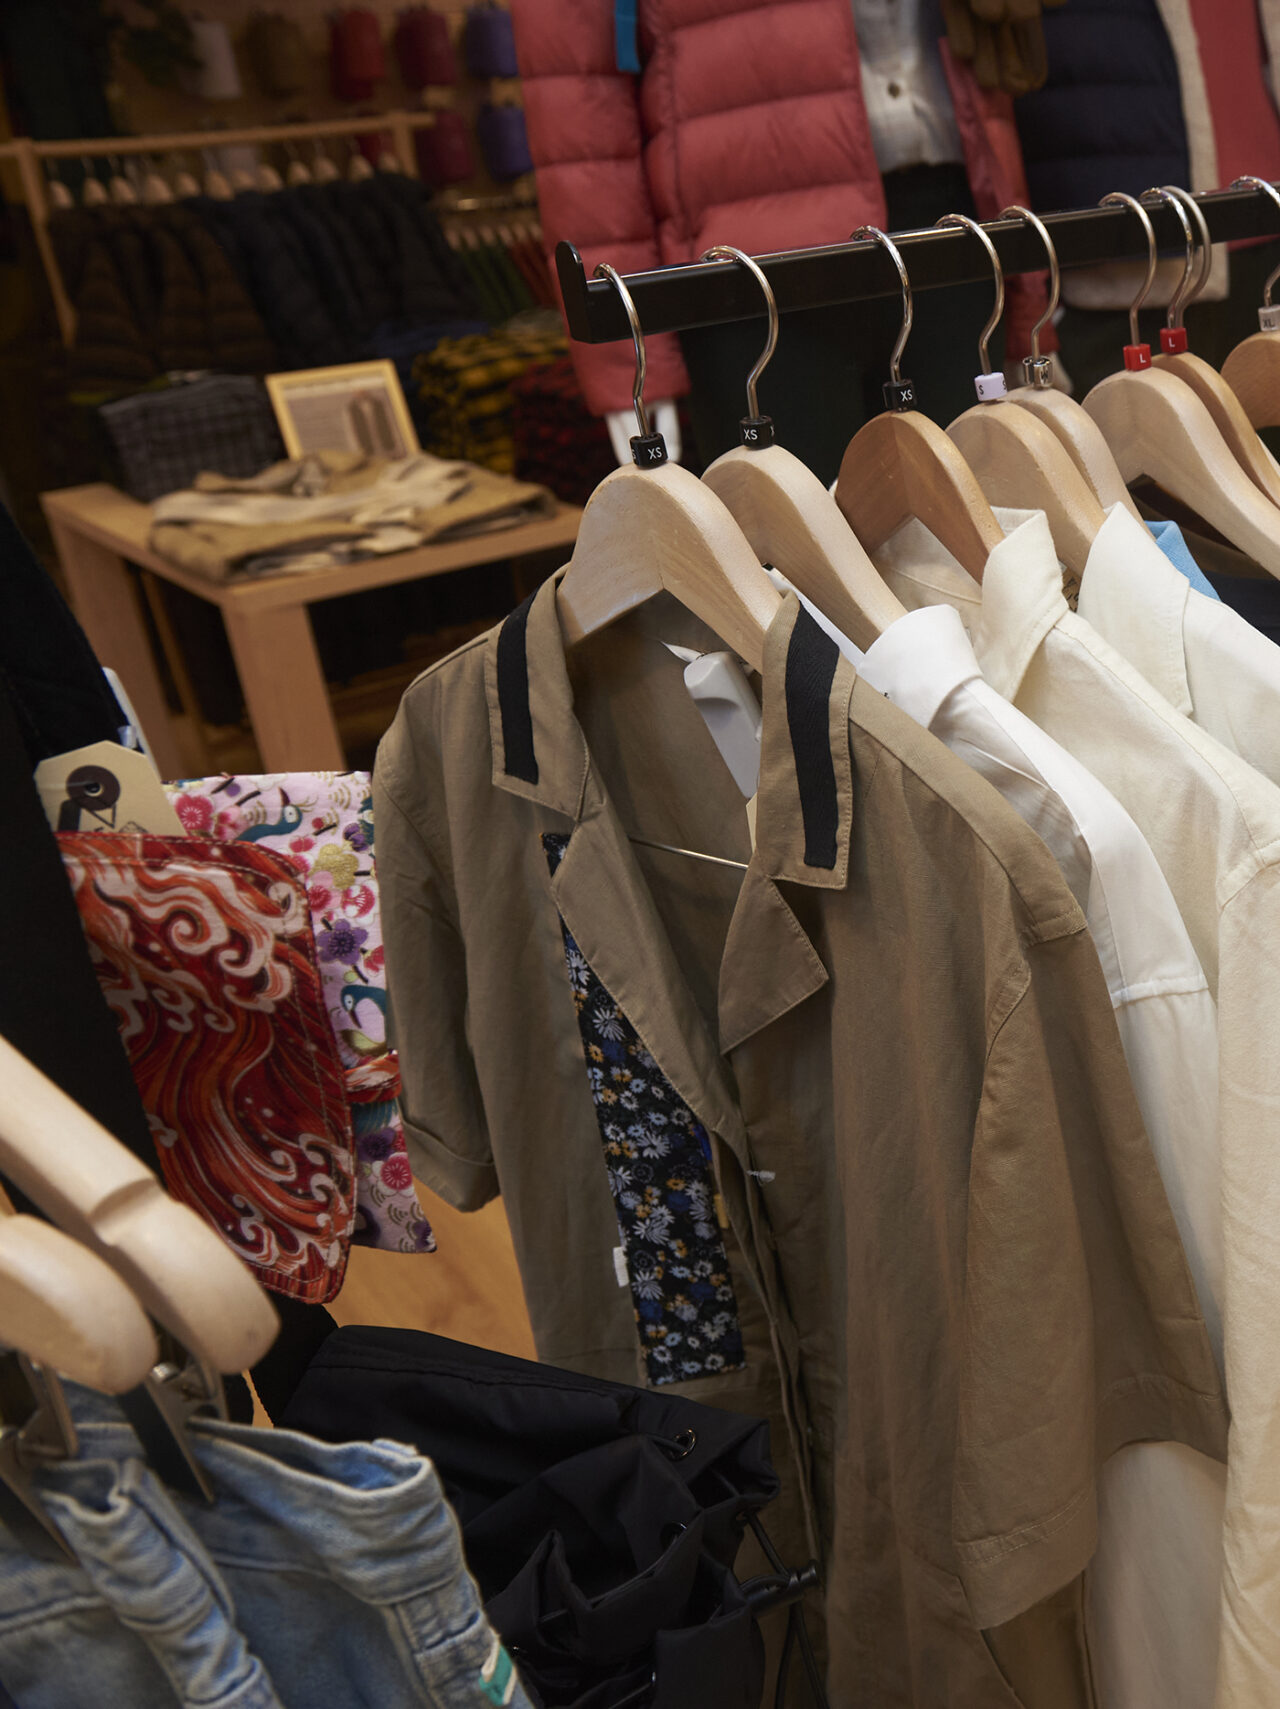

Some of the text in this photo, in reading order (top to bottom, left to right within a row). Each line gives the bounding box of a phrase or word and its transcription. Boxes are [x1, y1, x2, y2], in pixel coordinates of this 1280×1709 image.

[1262, 318, 1276, 329] XL
[1168, 336, 1176, 348] L
[1139, 353, 1147, 364] L
[900, 389, 913, 402] XS
[978, 384, 985, 395] S
[743, 428, 758, 441] XS
[647, 446, 662, 460] XS
